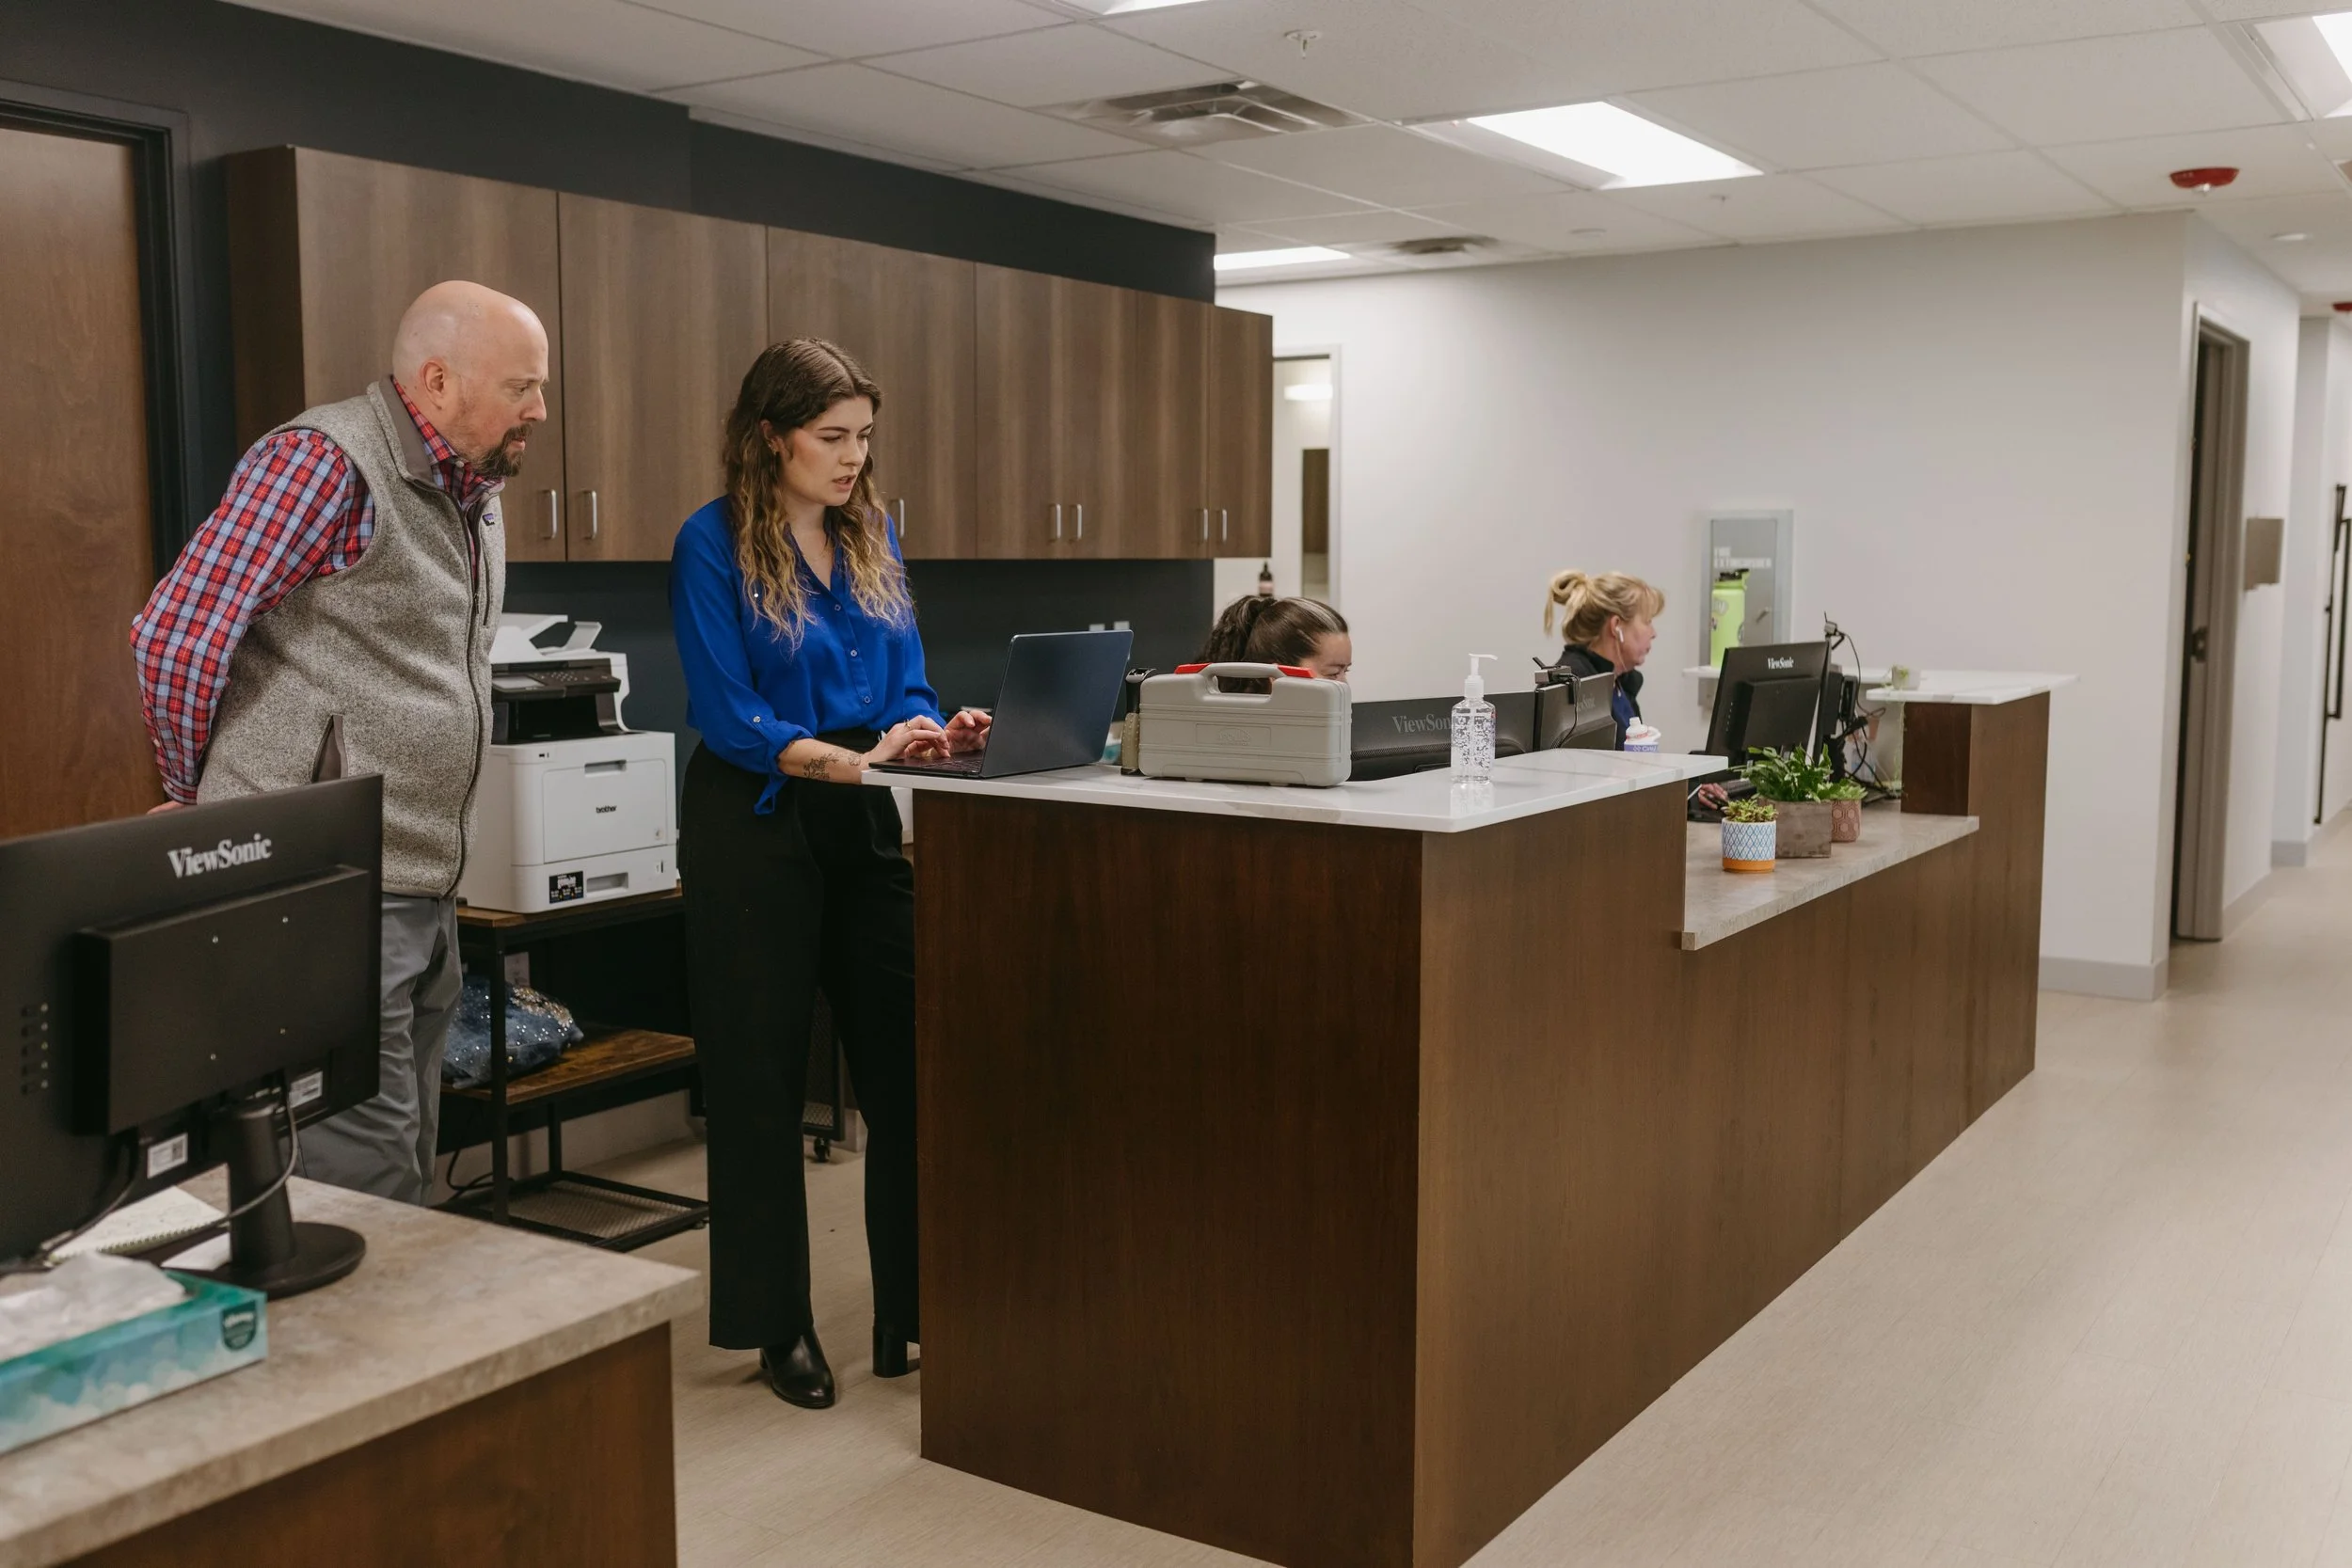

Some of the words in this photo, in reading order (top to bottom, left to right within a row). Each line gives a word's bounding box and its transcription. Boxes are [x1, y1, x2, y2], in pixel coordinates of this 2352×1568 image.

[1768, 656, 1794, 670] ViewSonic
[1392, 713, 1452, 734] ViewSon
[596, 805, 617, 814] brother
[167, 832, 273, 879] ViewSonic
